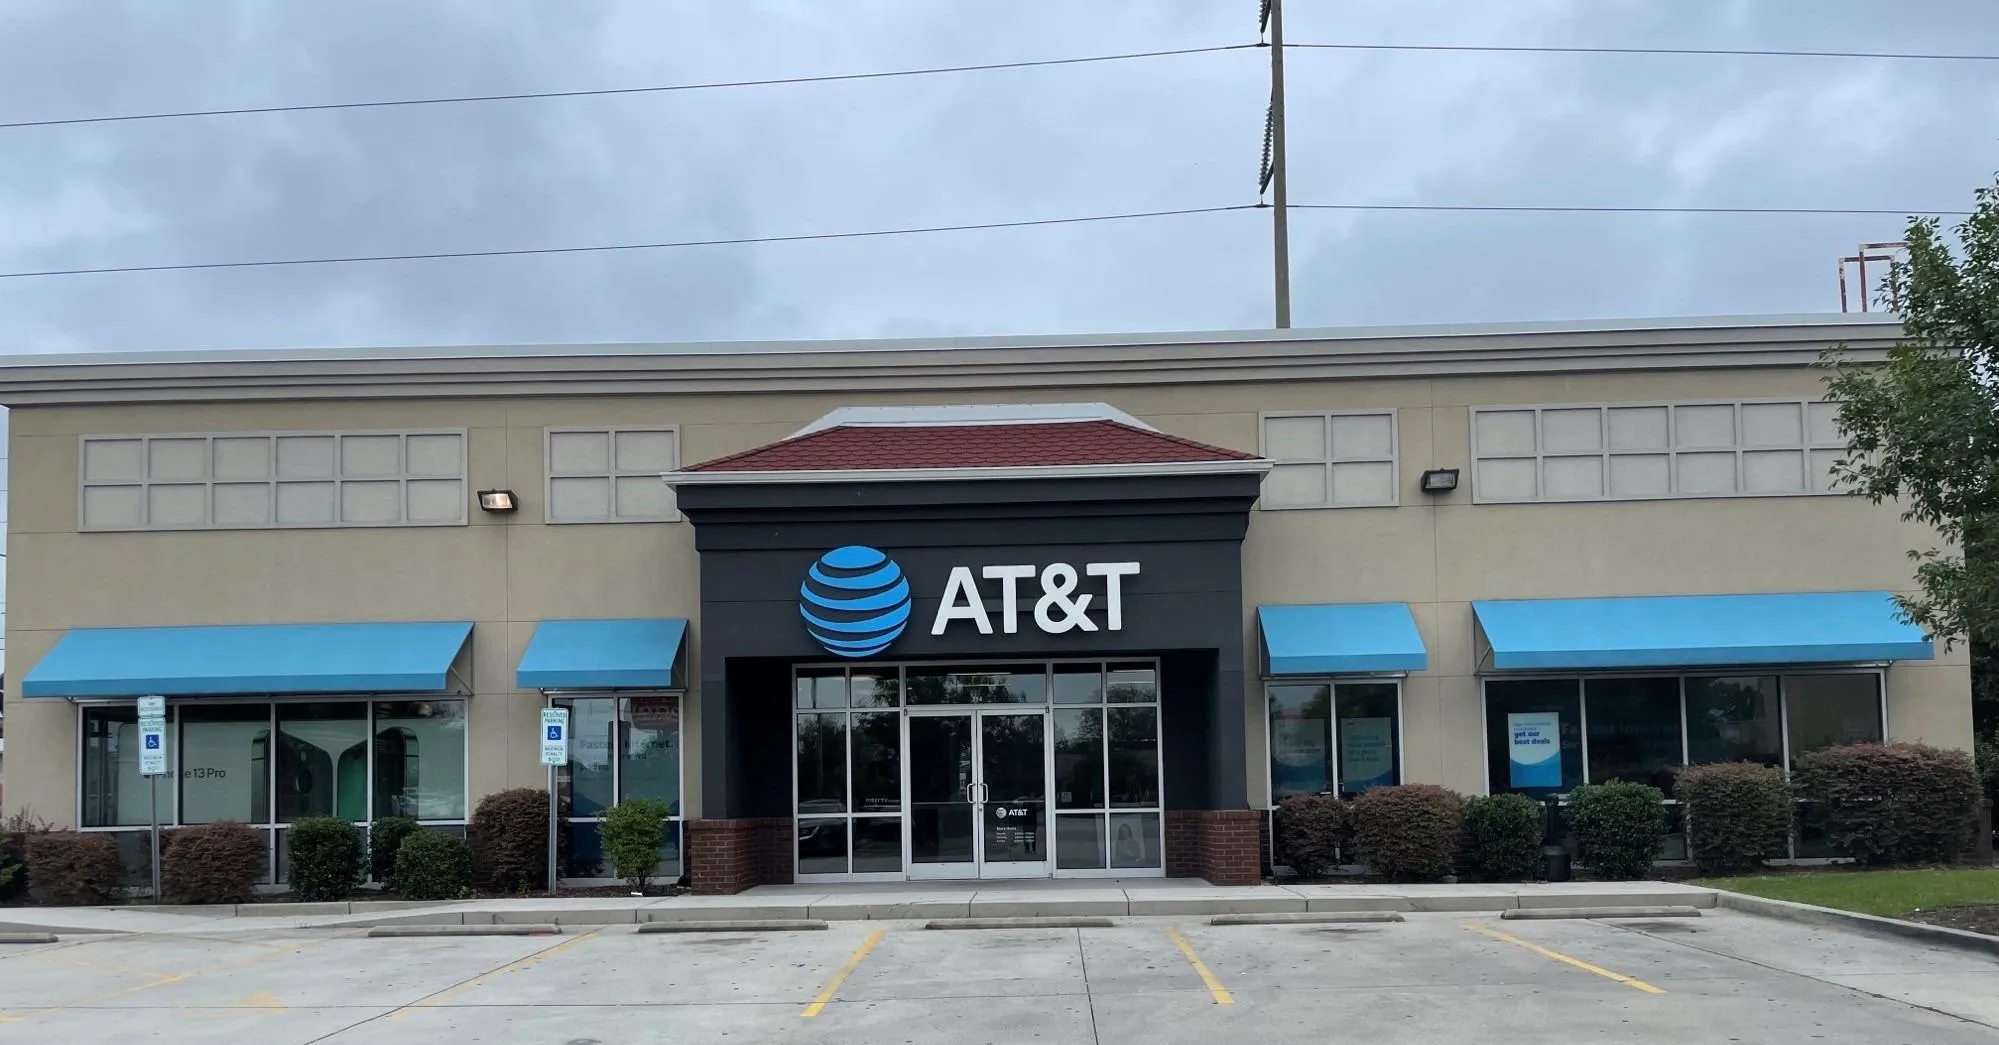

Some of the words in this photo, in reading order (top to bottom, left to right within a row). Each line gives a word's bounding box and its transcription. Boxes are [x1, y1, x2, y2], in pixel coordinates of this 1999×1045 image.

[931, 562, 1141, 635] AT&T
[193, 768, 205, 779] 13
[207, 767, 226, 778] Pro
[1008, 808, 1028, 817] AT&T
